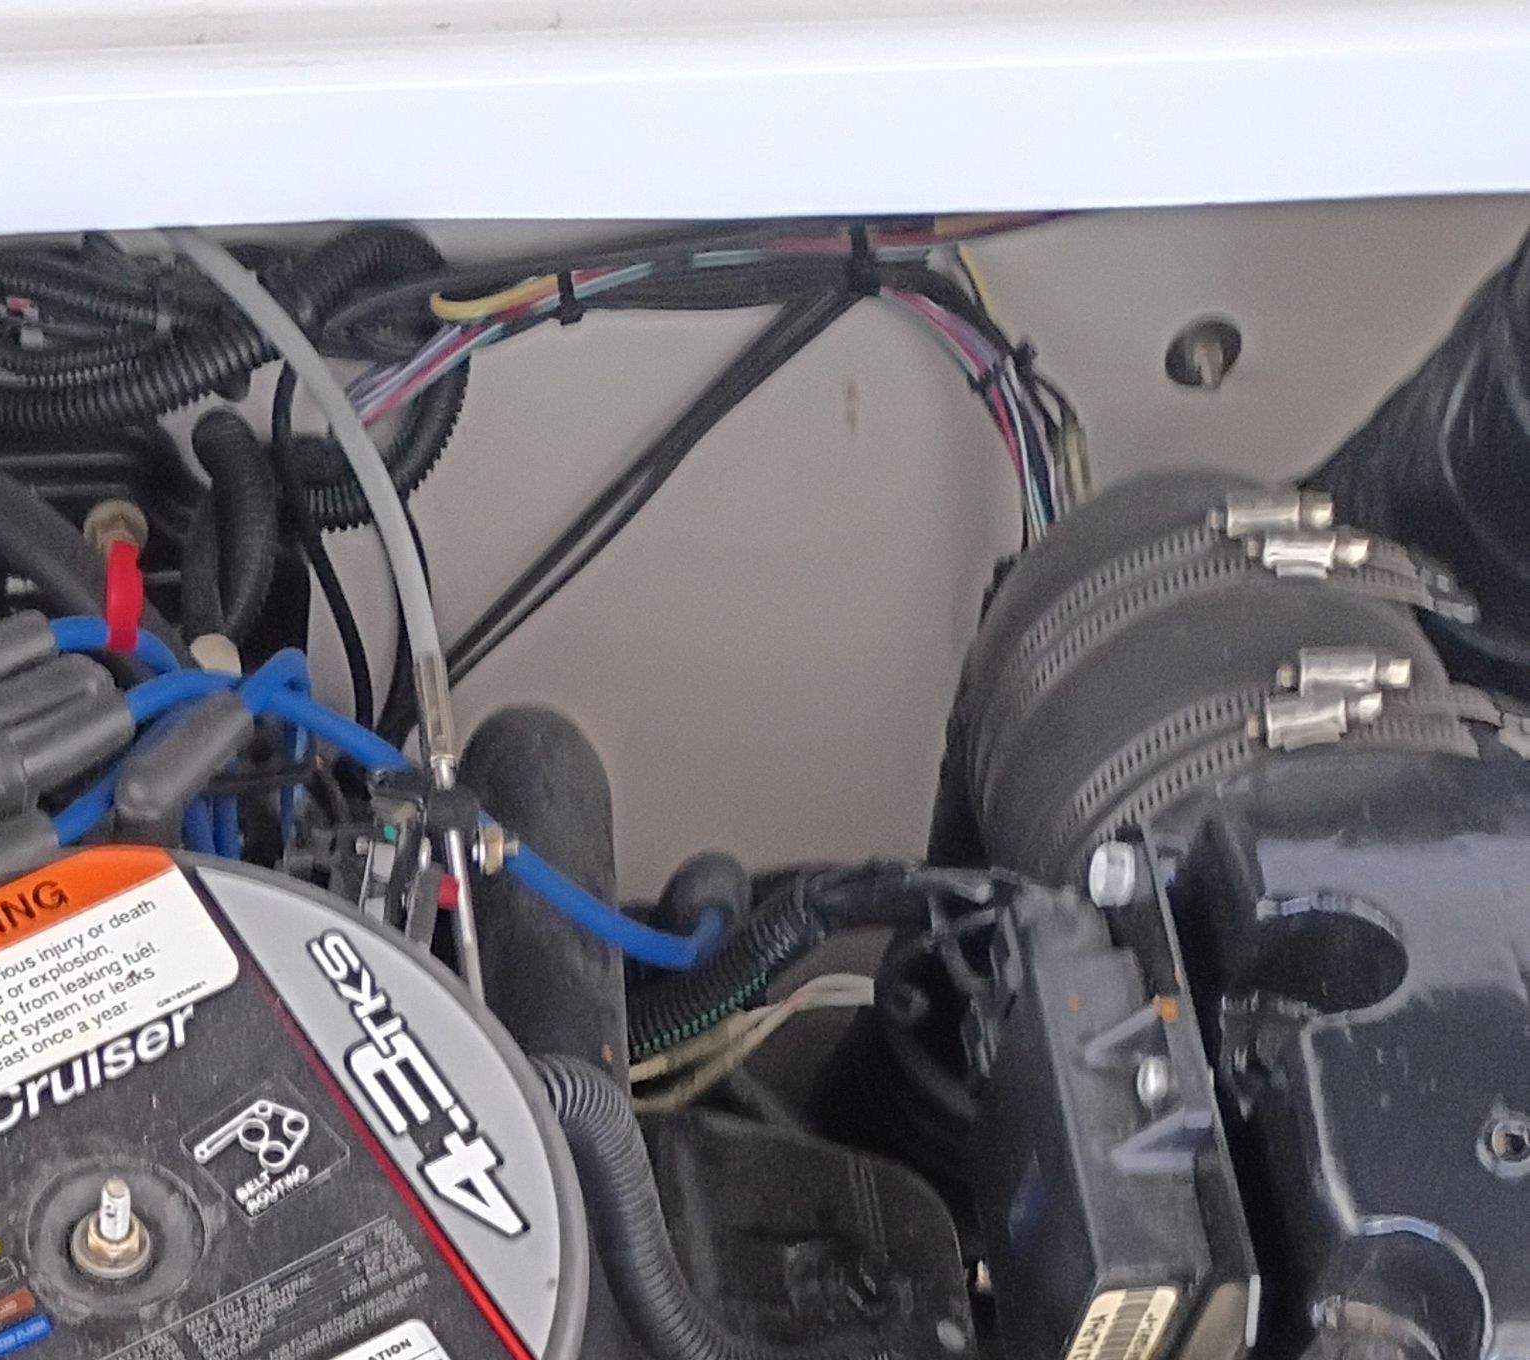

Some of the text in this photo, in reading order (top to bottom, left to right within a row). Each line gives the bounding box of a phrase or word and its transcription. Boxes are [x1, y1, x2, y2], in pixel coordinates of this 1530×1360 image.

[36, 930, 87, 965] injury
[85, 921, 106, 940] or
[106, 896, 157, 930] death
[4, 981, 27, 1000] or
[17, 986, 60, 1016] from
[59, 957, 123, 998] leaking
[121, 938, 161, 967] fuel.
[19, 999, 83, 1040] system
[80, 986, 107, 1008] for
[106, 963, 157, 996] leaks
[306, 927, 411, 1057] TKS
[29, 1025, 75, 1055] once
[76, 1019, 90, 1033] a
[89, 999, 134, 1030] year.
[235, 1171, 273, 1204] BELT
[244, 1164, 312, 1219] ROUTING
